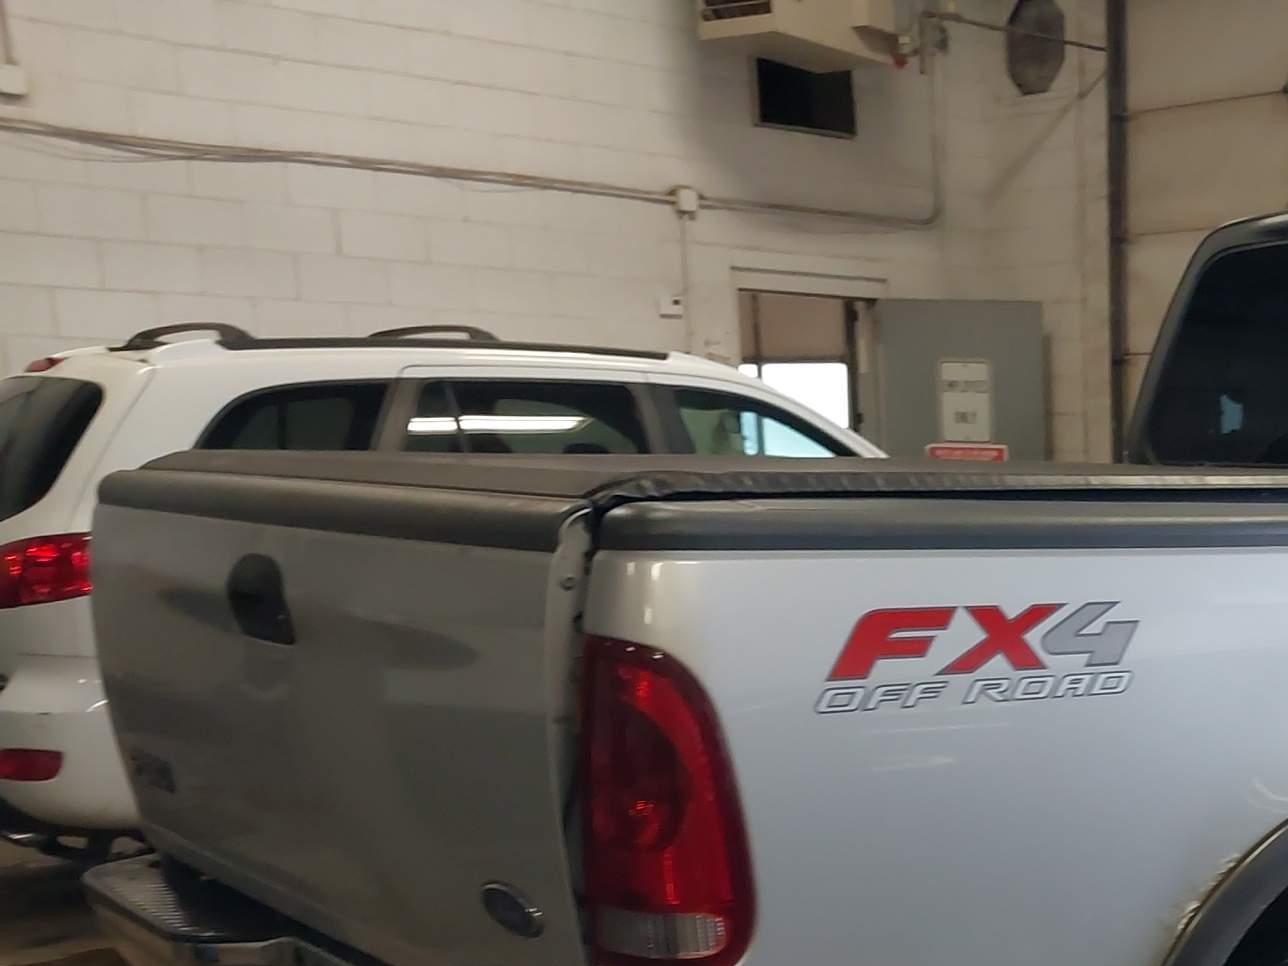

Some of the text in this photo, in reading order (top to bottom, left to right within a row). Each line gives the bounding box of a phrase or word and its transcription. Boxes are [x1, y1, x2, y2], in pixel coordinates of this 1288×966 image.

[826, 601, 1140, 682] FX4
[814, 670, 1133, 714] OFF ROAD
